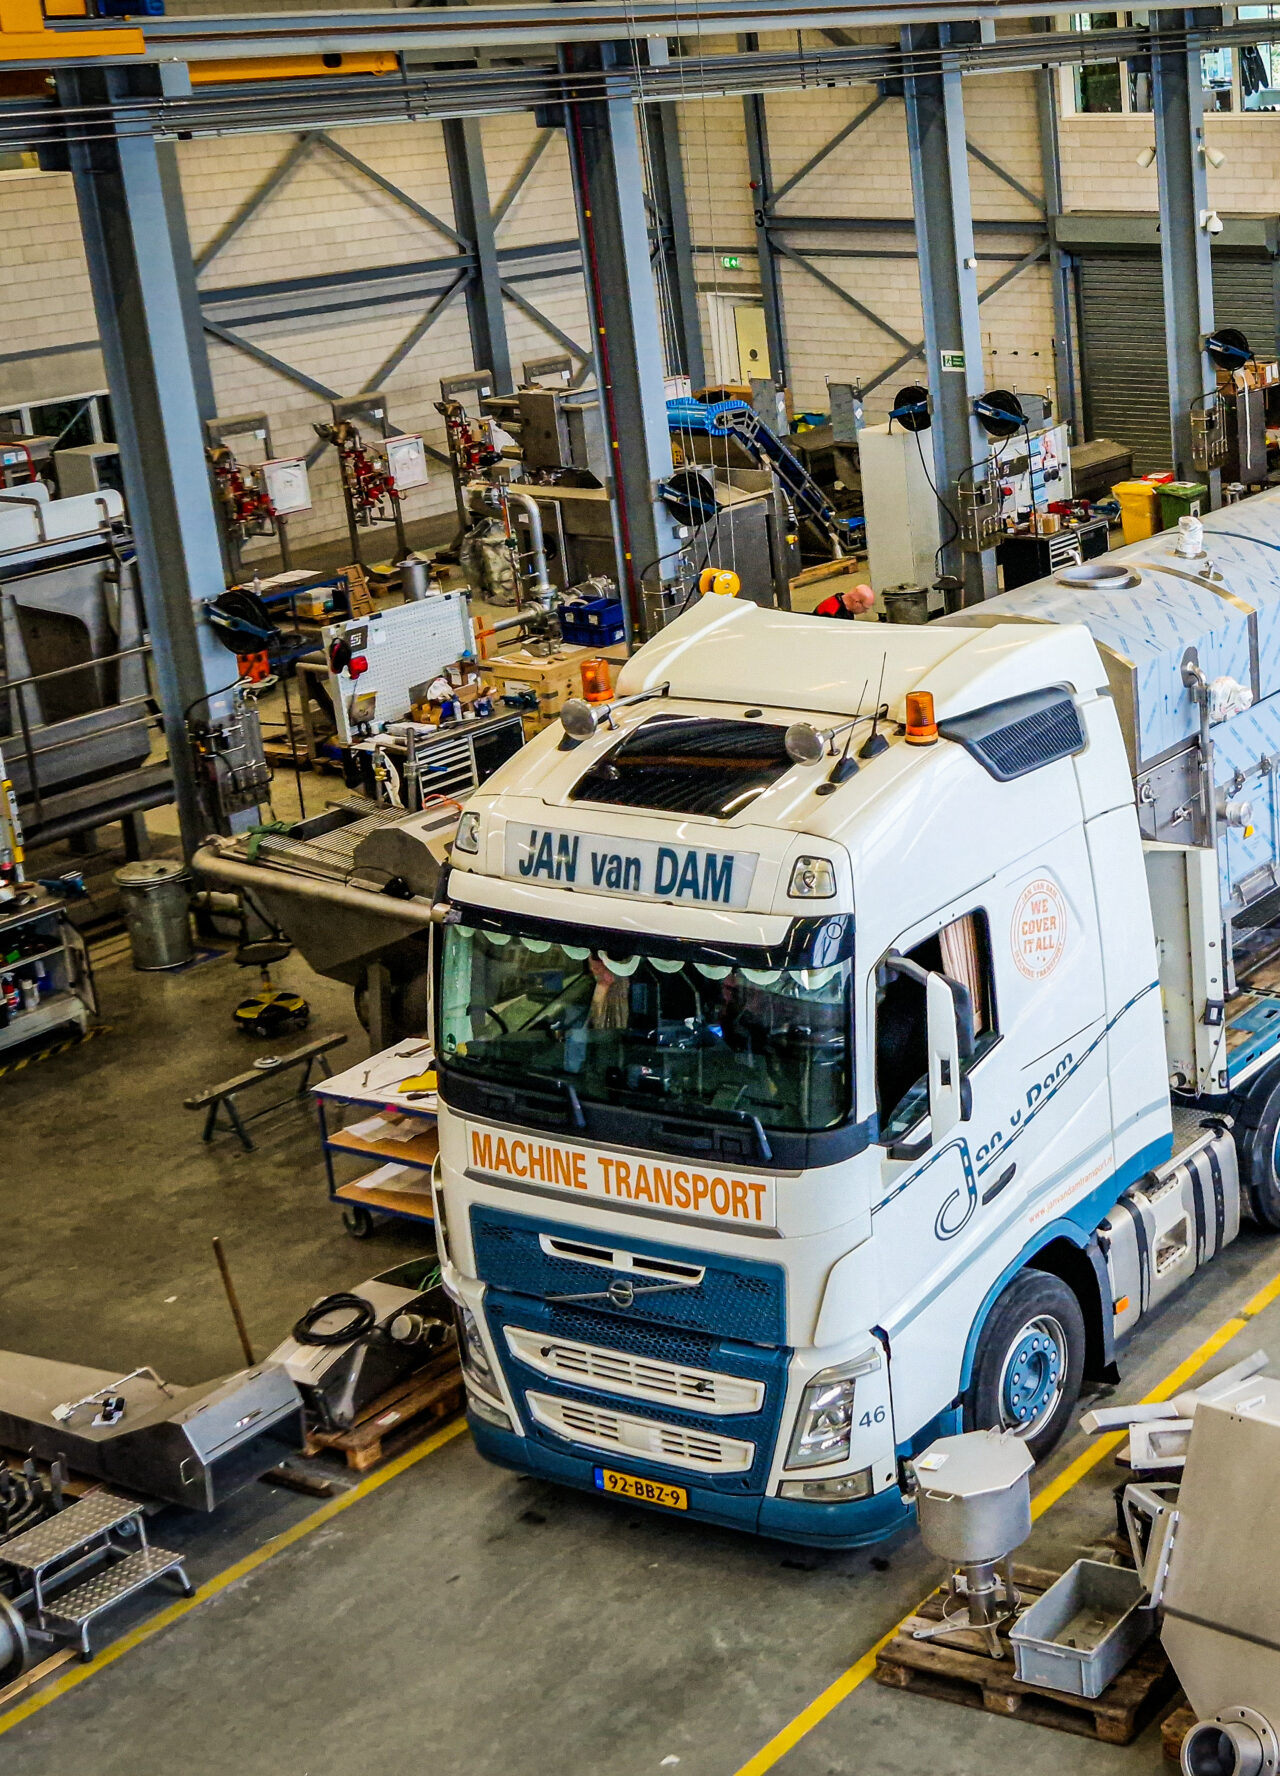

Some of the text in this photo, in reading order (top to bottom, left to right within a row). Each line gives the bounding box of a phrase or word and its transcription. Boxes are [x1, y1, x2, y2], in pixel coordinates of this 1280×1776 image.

[754, 209, 765, 228] 3
[518, 830, 735, 904] JAN van DAM
[1031, 898, 1049, 915] WE
[1021, 915, 1057, 936] COVER
[1023, 934, 1055, 954] IT ALL
[471, 1130, 767, 1220] MACHINE TRANSPORT
[858, 1404, 886, 1428] 46
[608, 1474, 681, 1506] 92-BBZ-9
